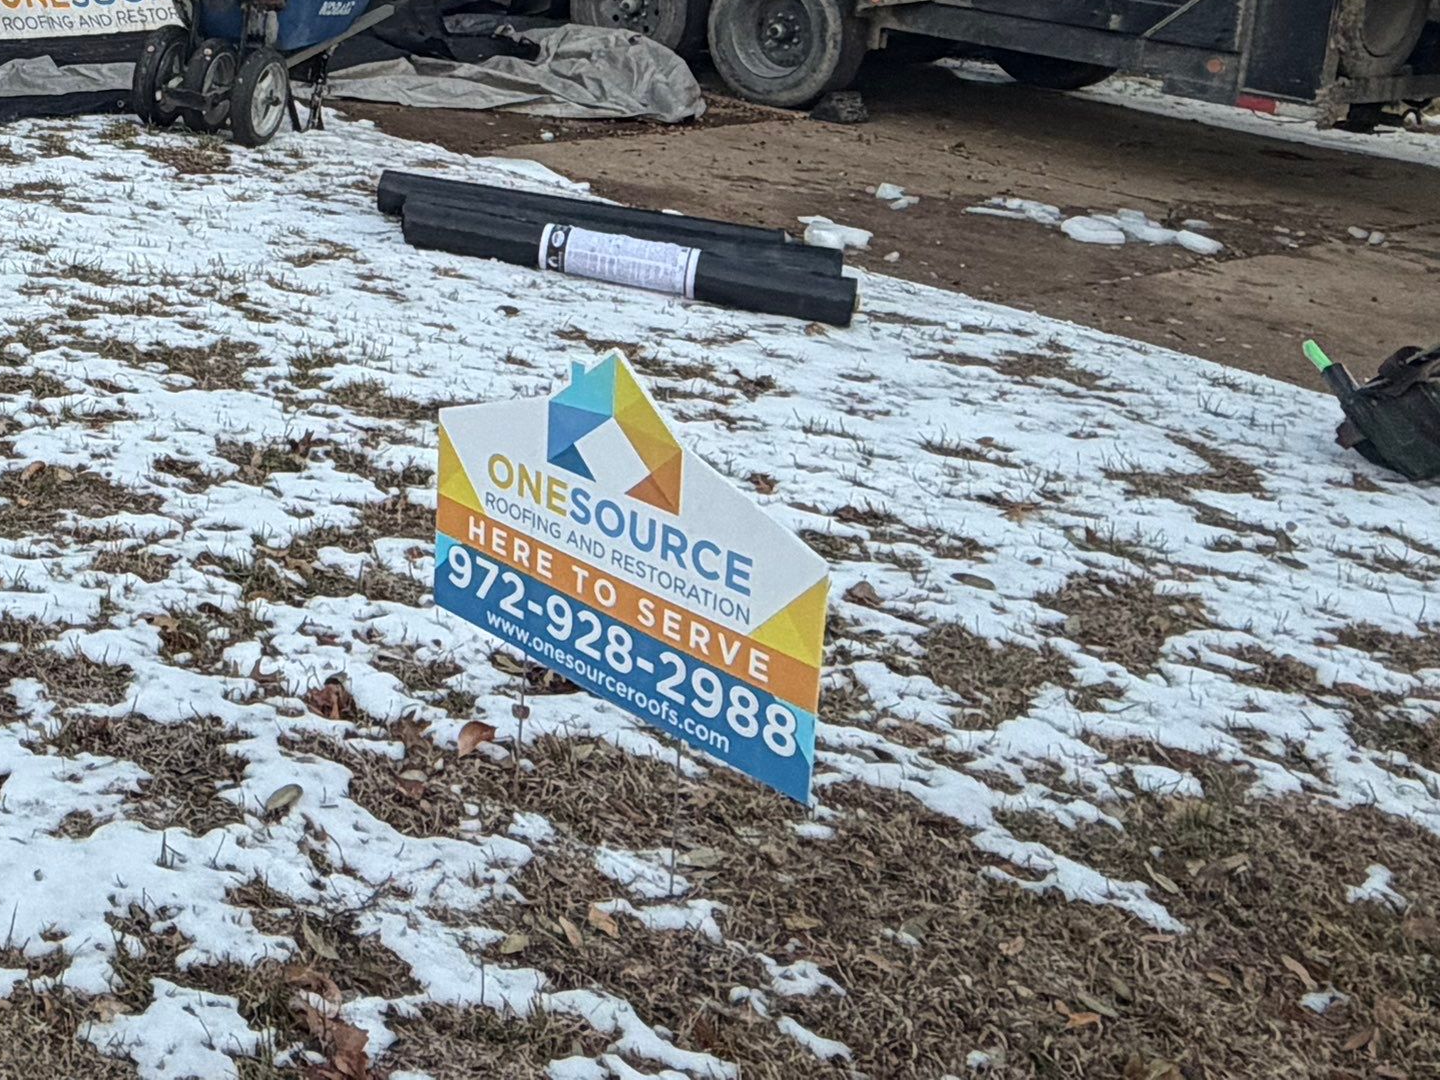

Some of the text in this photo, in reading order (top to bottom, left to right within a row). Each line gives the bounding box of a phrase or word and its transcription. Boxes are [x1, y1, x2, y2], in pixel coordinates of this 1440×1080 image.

[1, 6, 180, 32] ROOFING AND RESTOR
[485, 491, 750, 626] ROOFING AND RESTORATION
[487, 453, 754, 597] ONESOURCE
[448, 545, 797, 758] 972-928-2988
[468, 515, 770, 683] HERE TO SERVE
[486, 610, 730, 755] www.onesourceroofs.com
